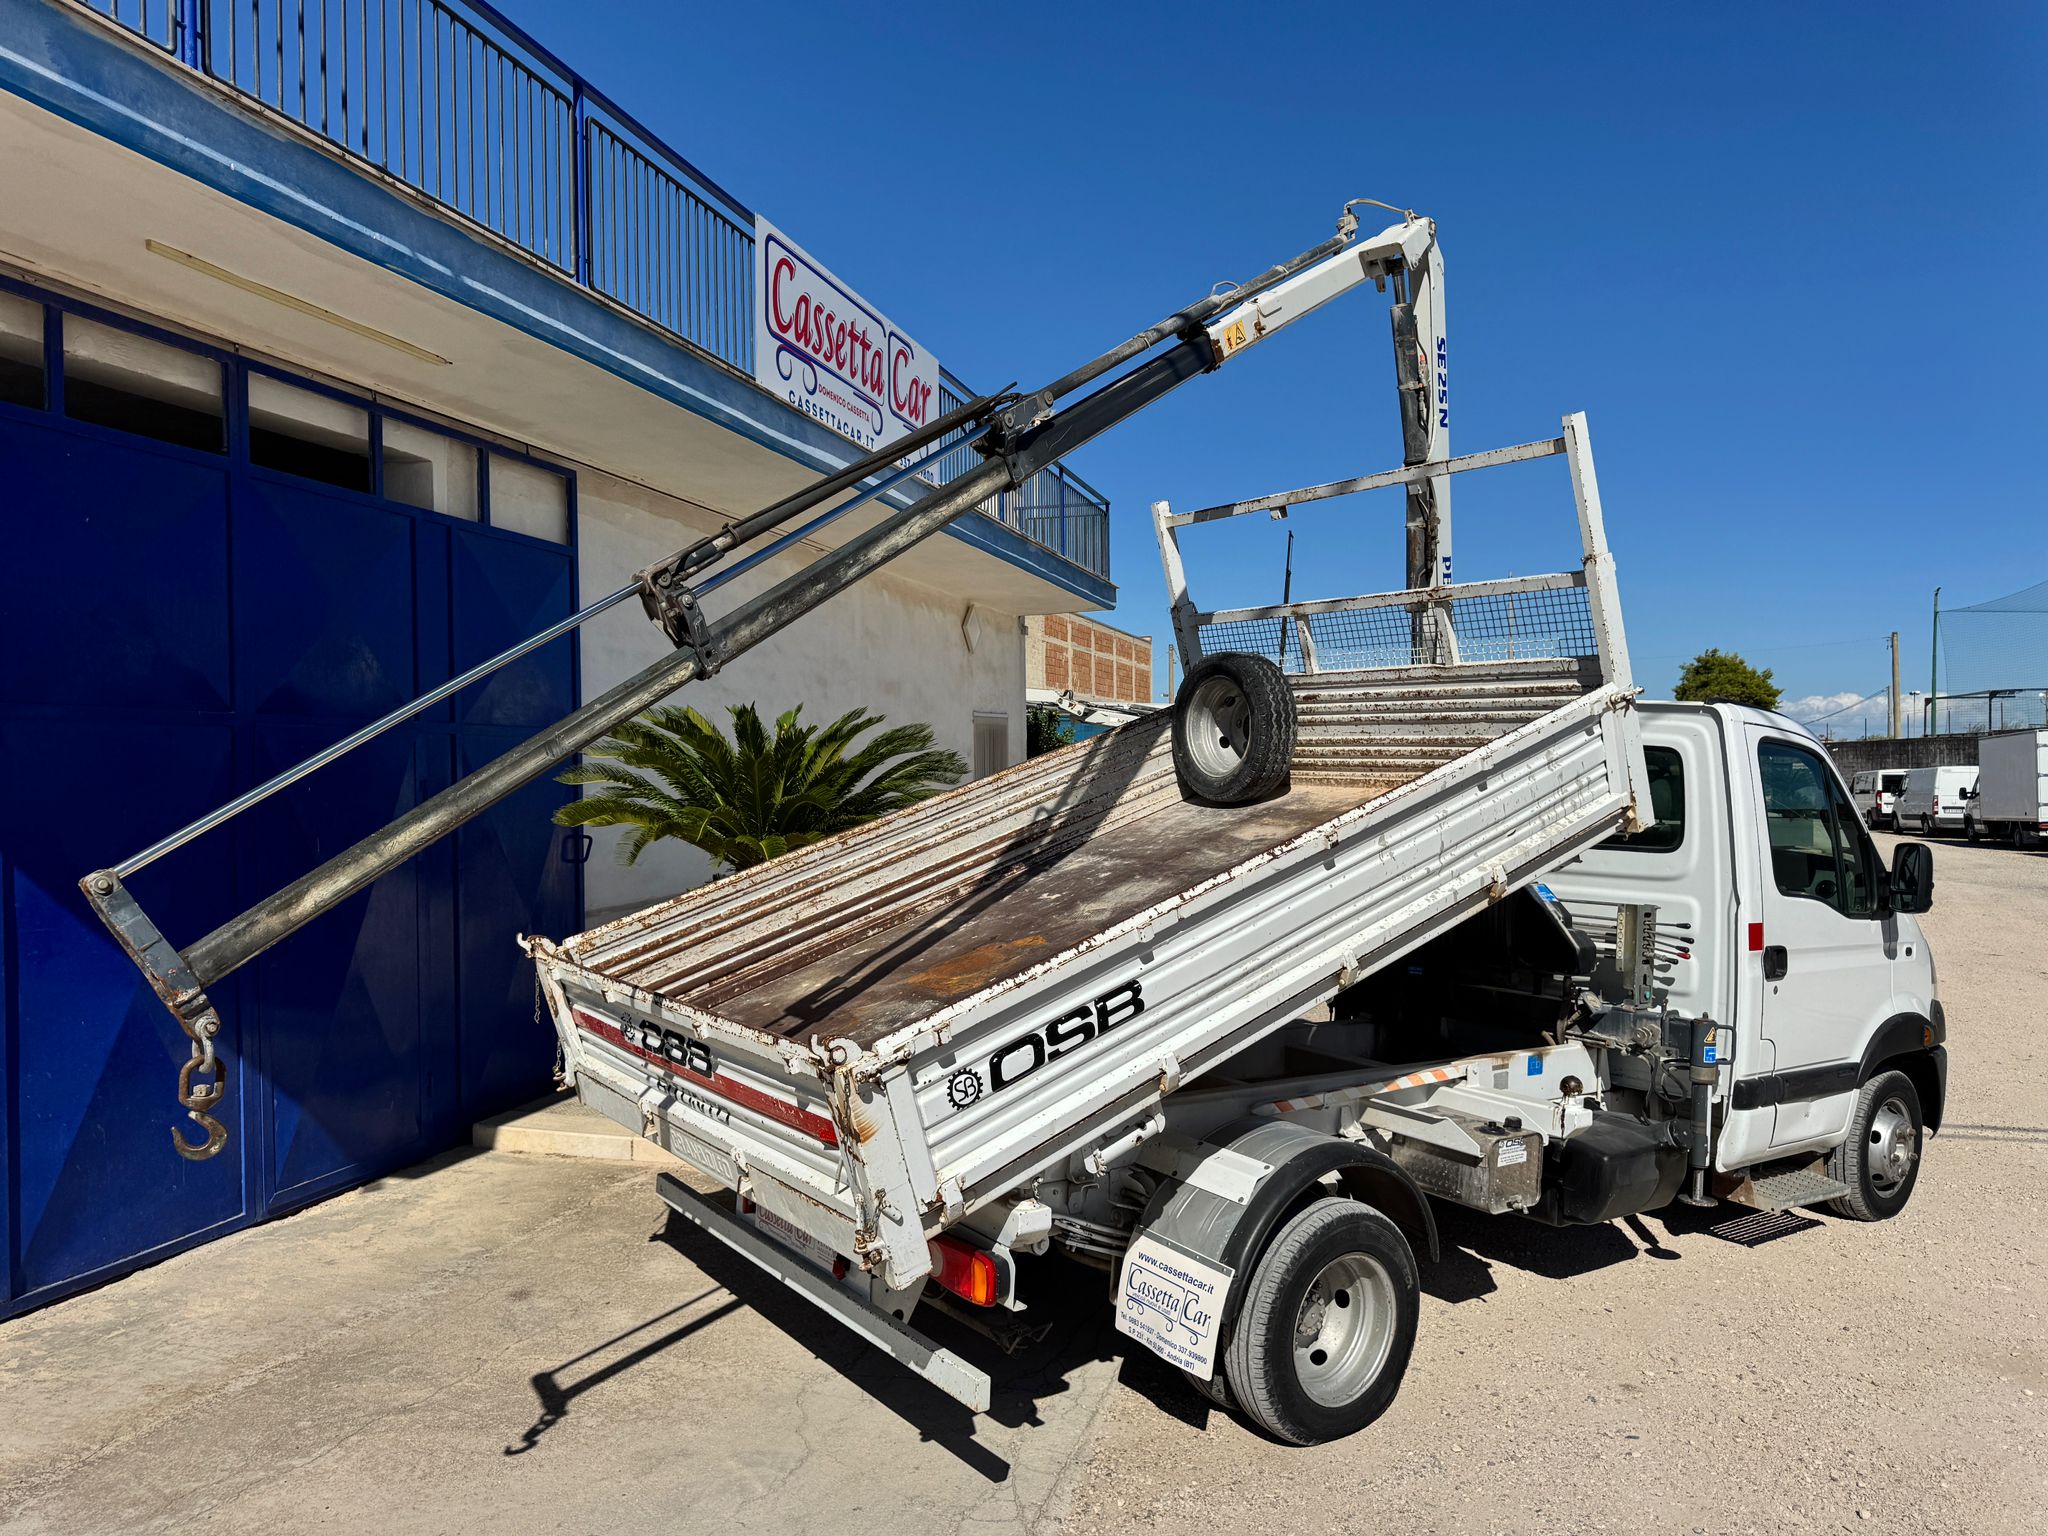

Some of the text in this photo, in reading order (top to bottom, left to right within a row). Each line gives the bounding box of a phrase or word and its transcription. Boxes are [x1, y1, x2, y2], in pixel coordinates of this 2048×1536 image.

[772, 254, 932, 426] Cassetta Car
[788, 389, 875, 450] CASSETTACAR.IT
[818, 383, 870, 423] DOMENICO CASSETTA
[988, 979, 1146, 1093] OSB
[1129, 1268, 1212, 1328] Cassetta Car
[1138, 1252, 1215, 1295] www.cassettacar.it
